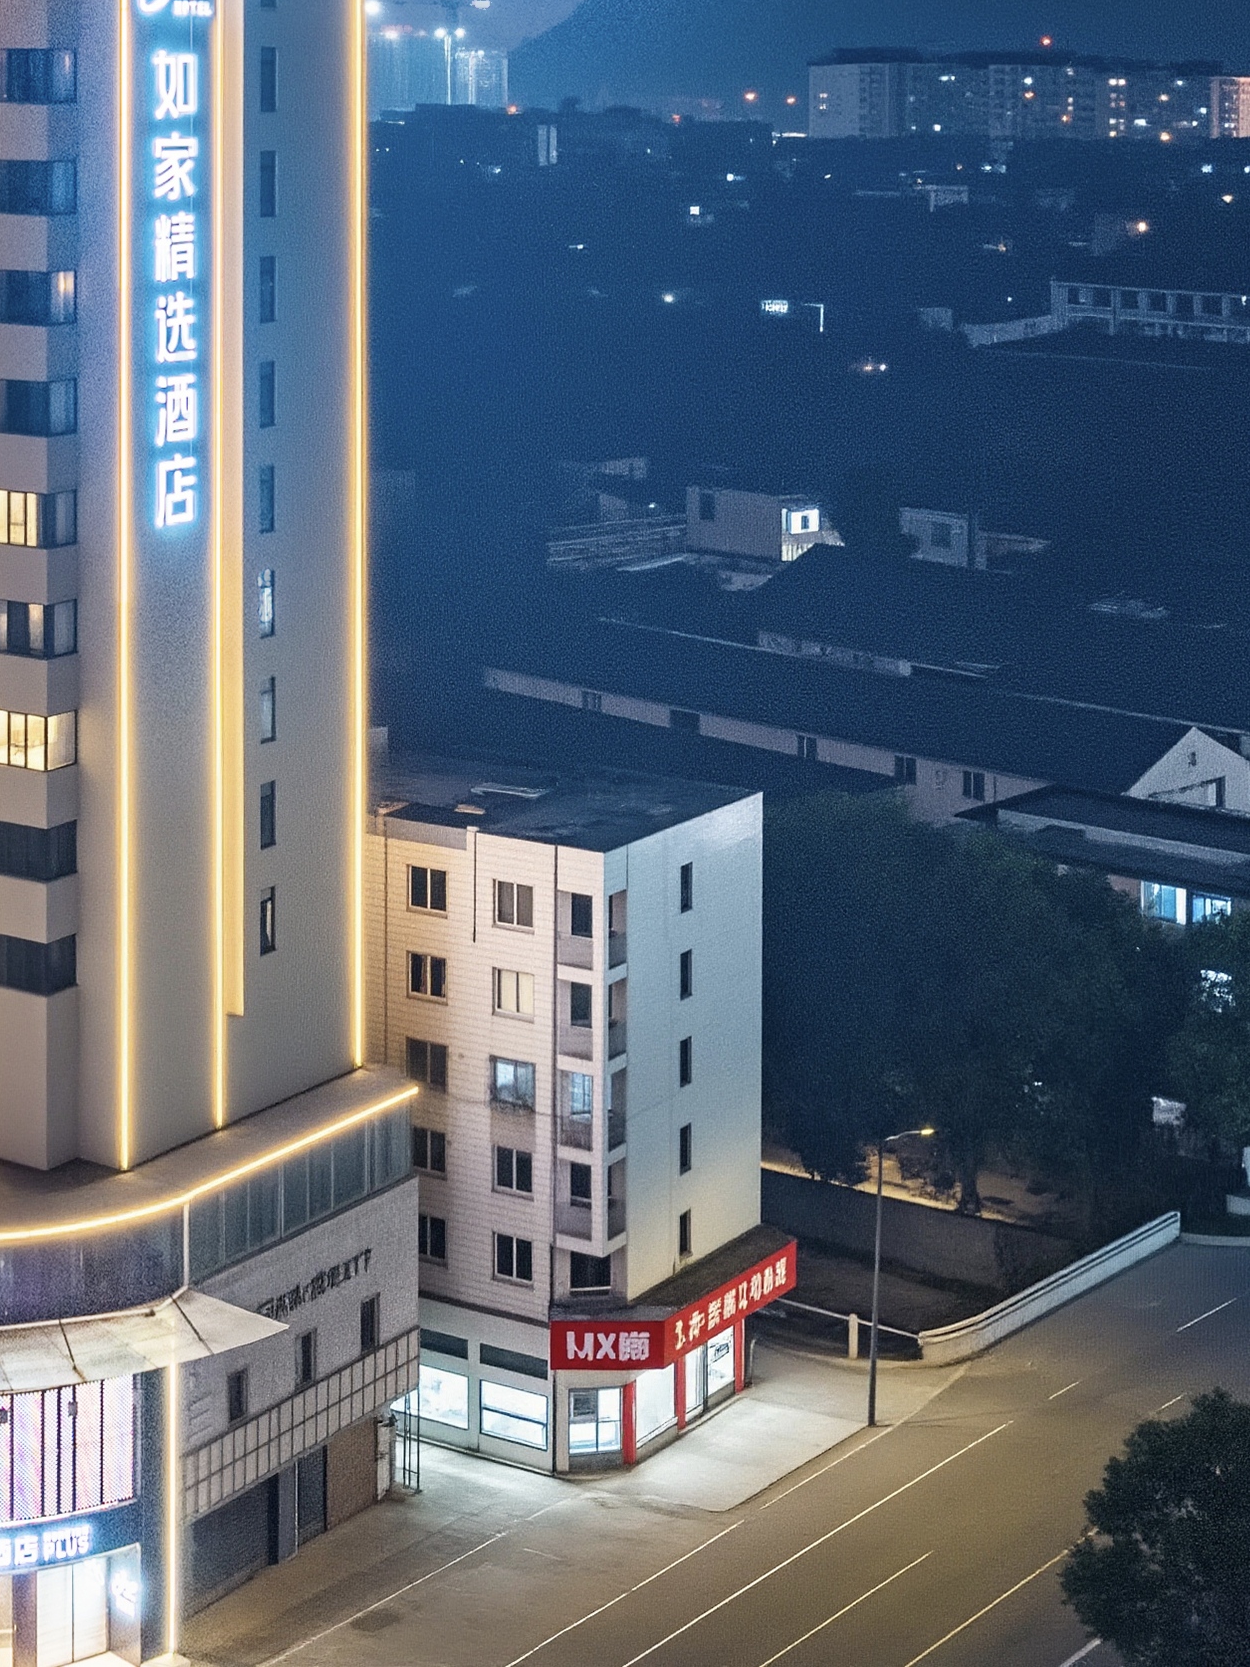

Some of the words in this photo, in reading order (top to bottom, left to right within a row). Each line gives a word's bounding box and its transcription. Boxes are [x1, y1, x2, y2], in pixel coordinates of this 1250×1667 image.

[153, 50, 197, 529] 如家精选酒店
[43, 1535, 89, 1561] PLUS
